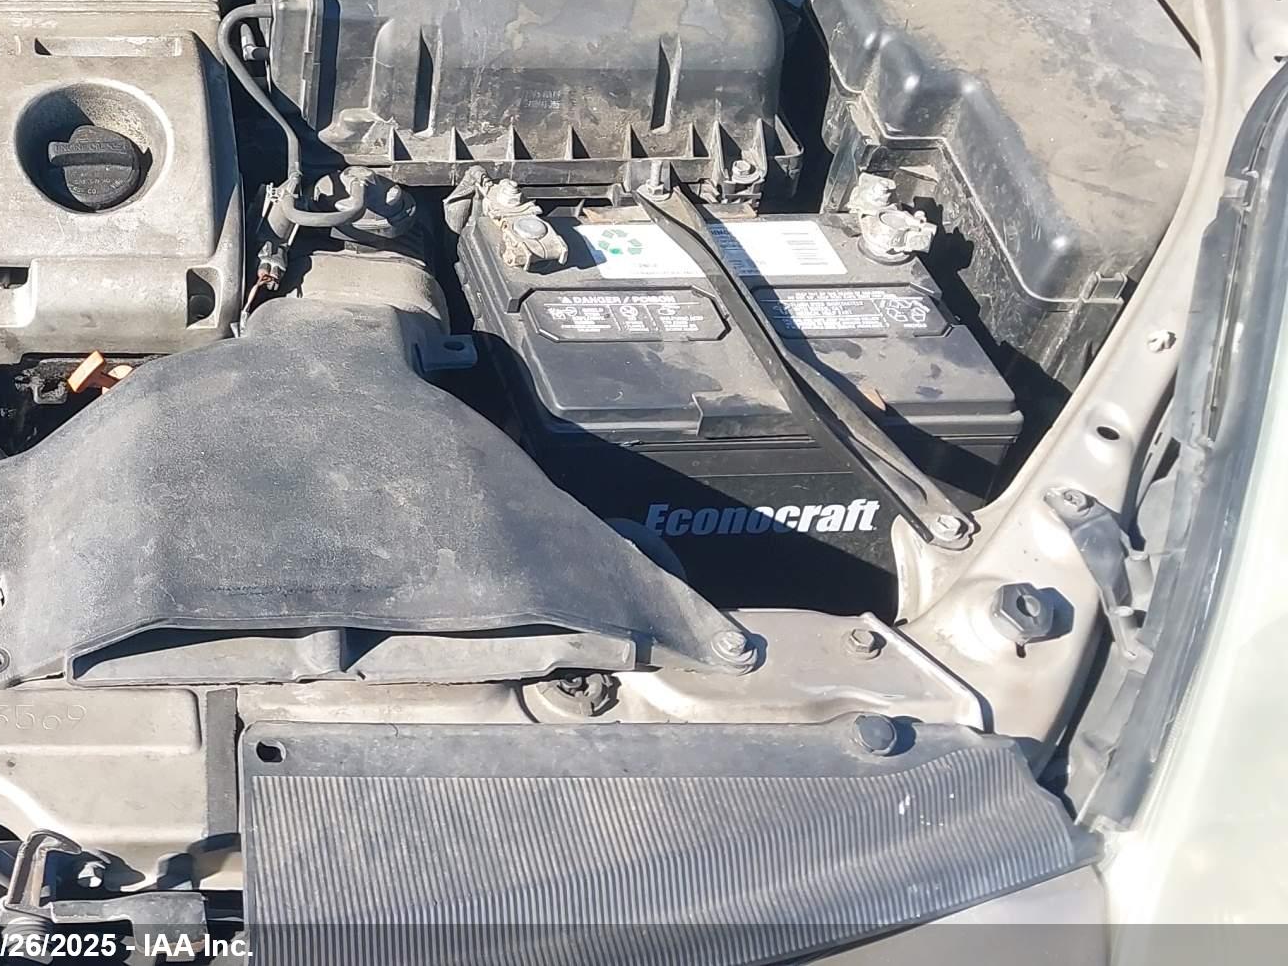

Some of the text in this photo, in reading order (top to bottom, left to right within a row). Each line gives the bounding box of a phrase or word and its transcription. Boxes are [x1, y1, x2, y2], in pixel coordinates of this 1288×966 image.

[573, 295, 621, 304] DANGER
[631, 294, 677, 303] POISON
[645, 498, 880, 536] Econocraft
